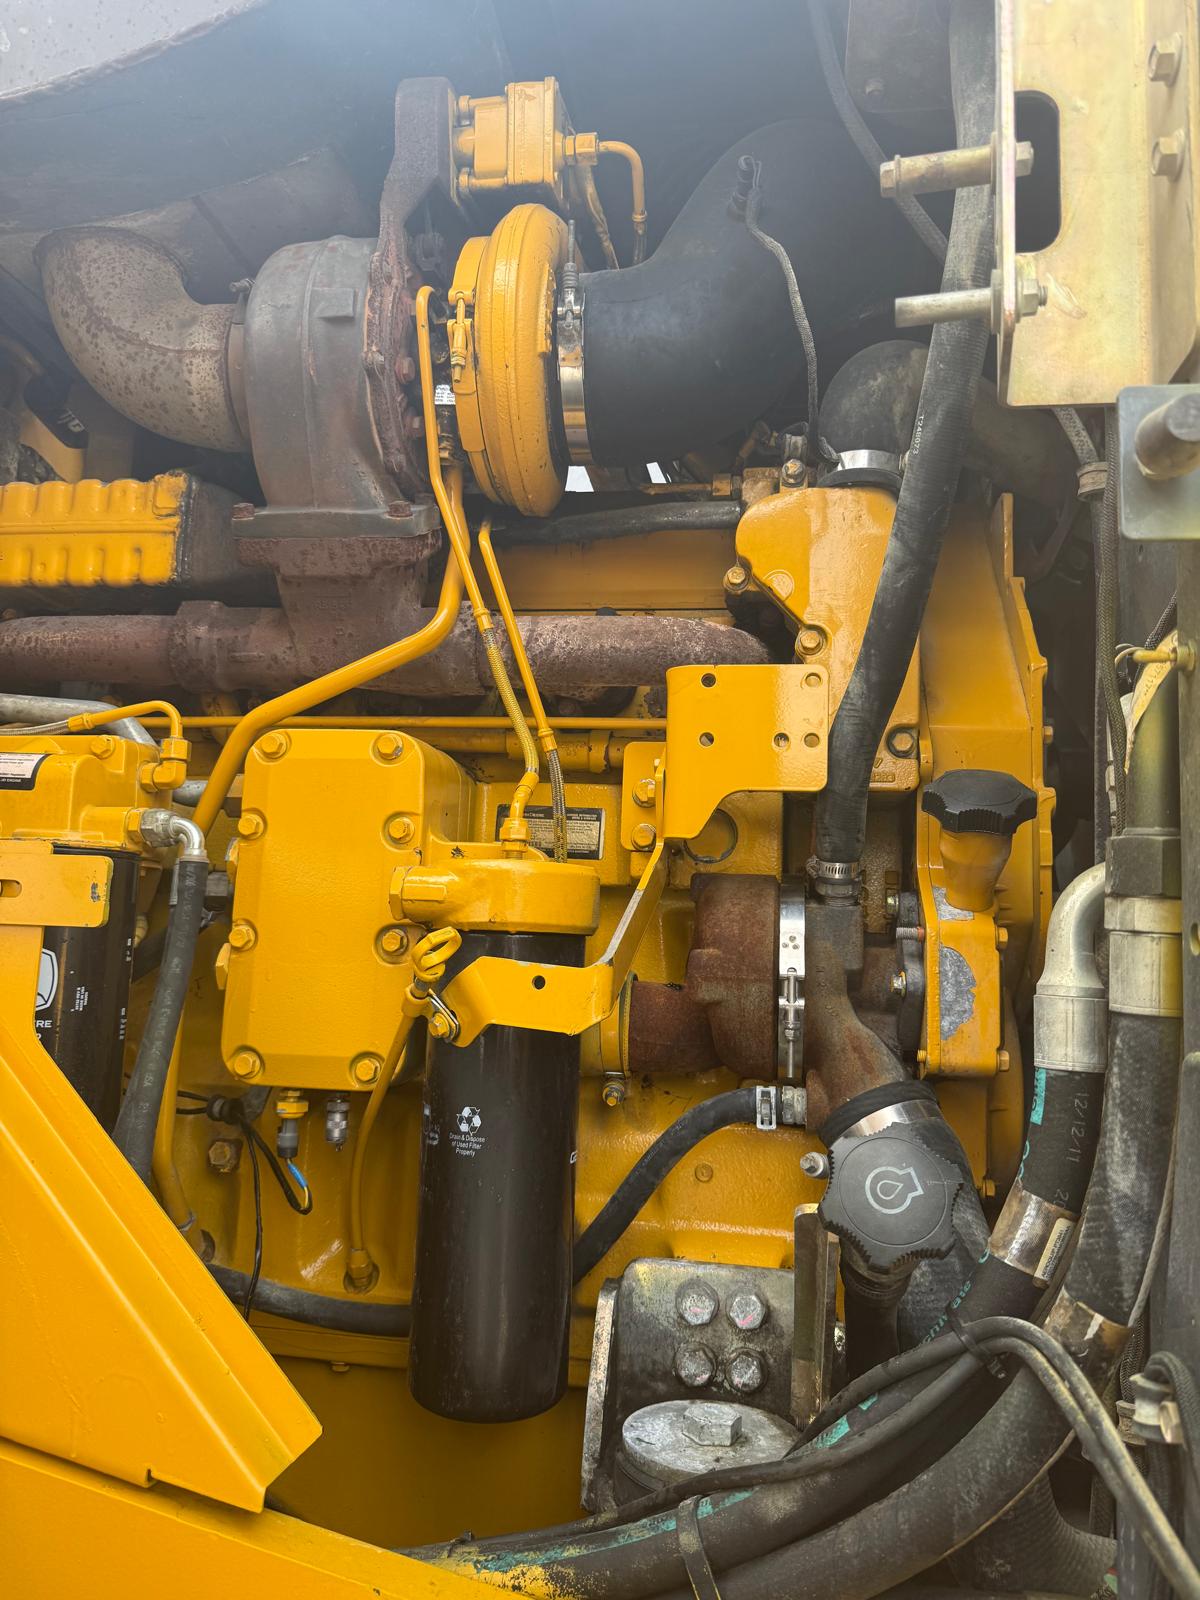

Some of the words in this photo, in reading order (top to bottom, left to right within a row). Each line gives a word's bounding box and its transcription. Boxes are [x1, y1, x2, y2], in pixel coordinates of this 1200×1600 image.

[34, 1019, 53, 1028] RE
[456, 1141, 468, 1149] Used
[468, 1142, 482, 1150] Filter
[455, 1147, 476, 1158] Properly
